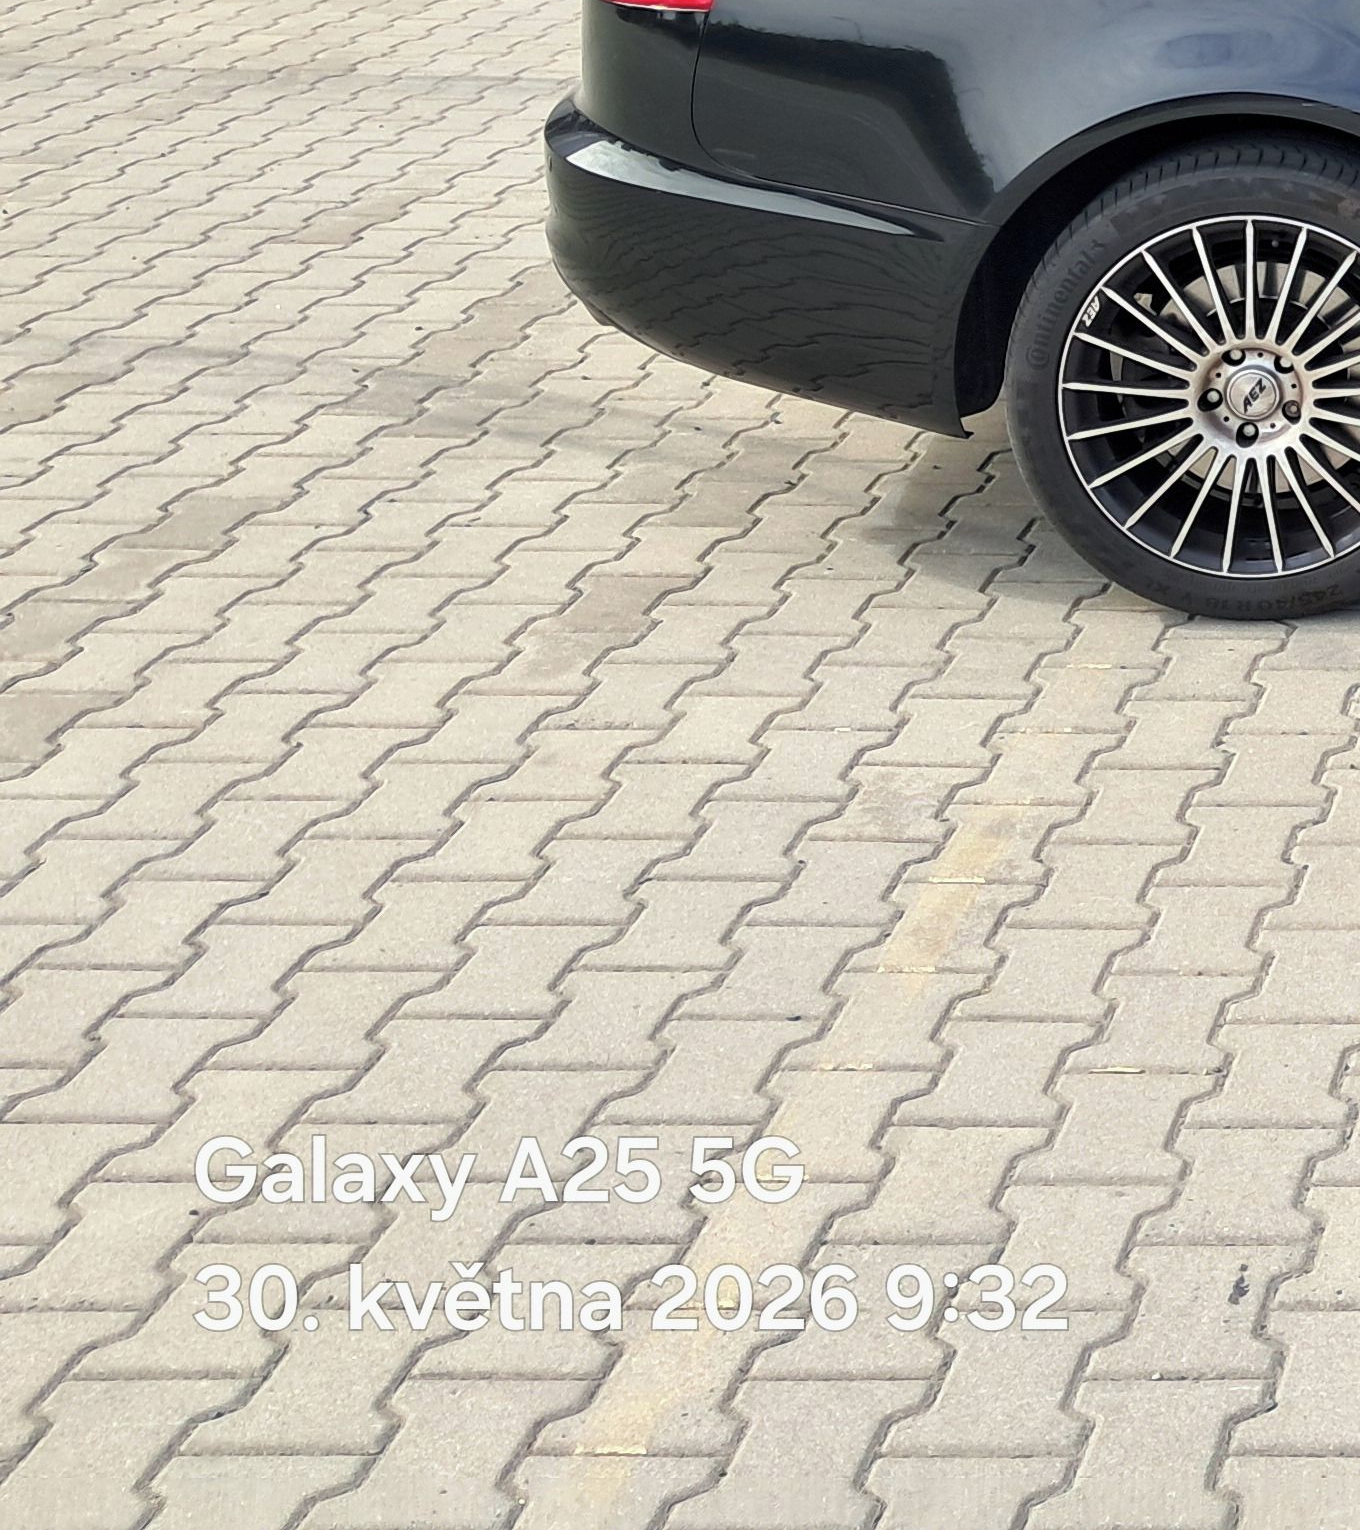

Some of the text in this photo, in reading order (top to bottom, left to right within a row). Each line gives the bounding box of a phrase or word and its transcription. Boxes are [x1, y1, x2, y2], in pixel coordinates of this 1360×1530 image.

[1026, 250, 1096, 368] Continental
[1080, 295, 1100, 328] AEZ
[1243, 377, 1267, 415] AEZ
